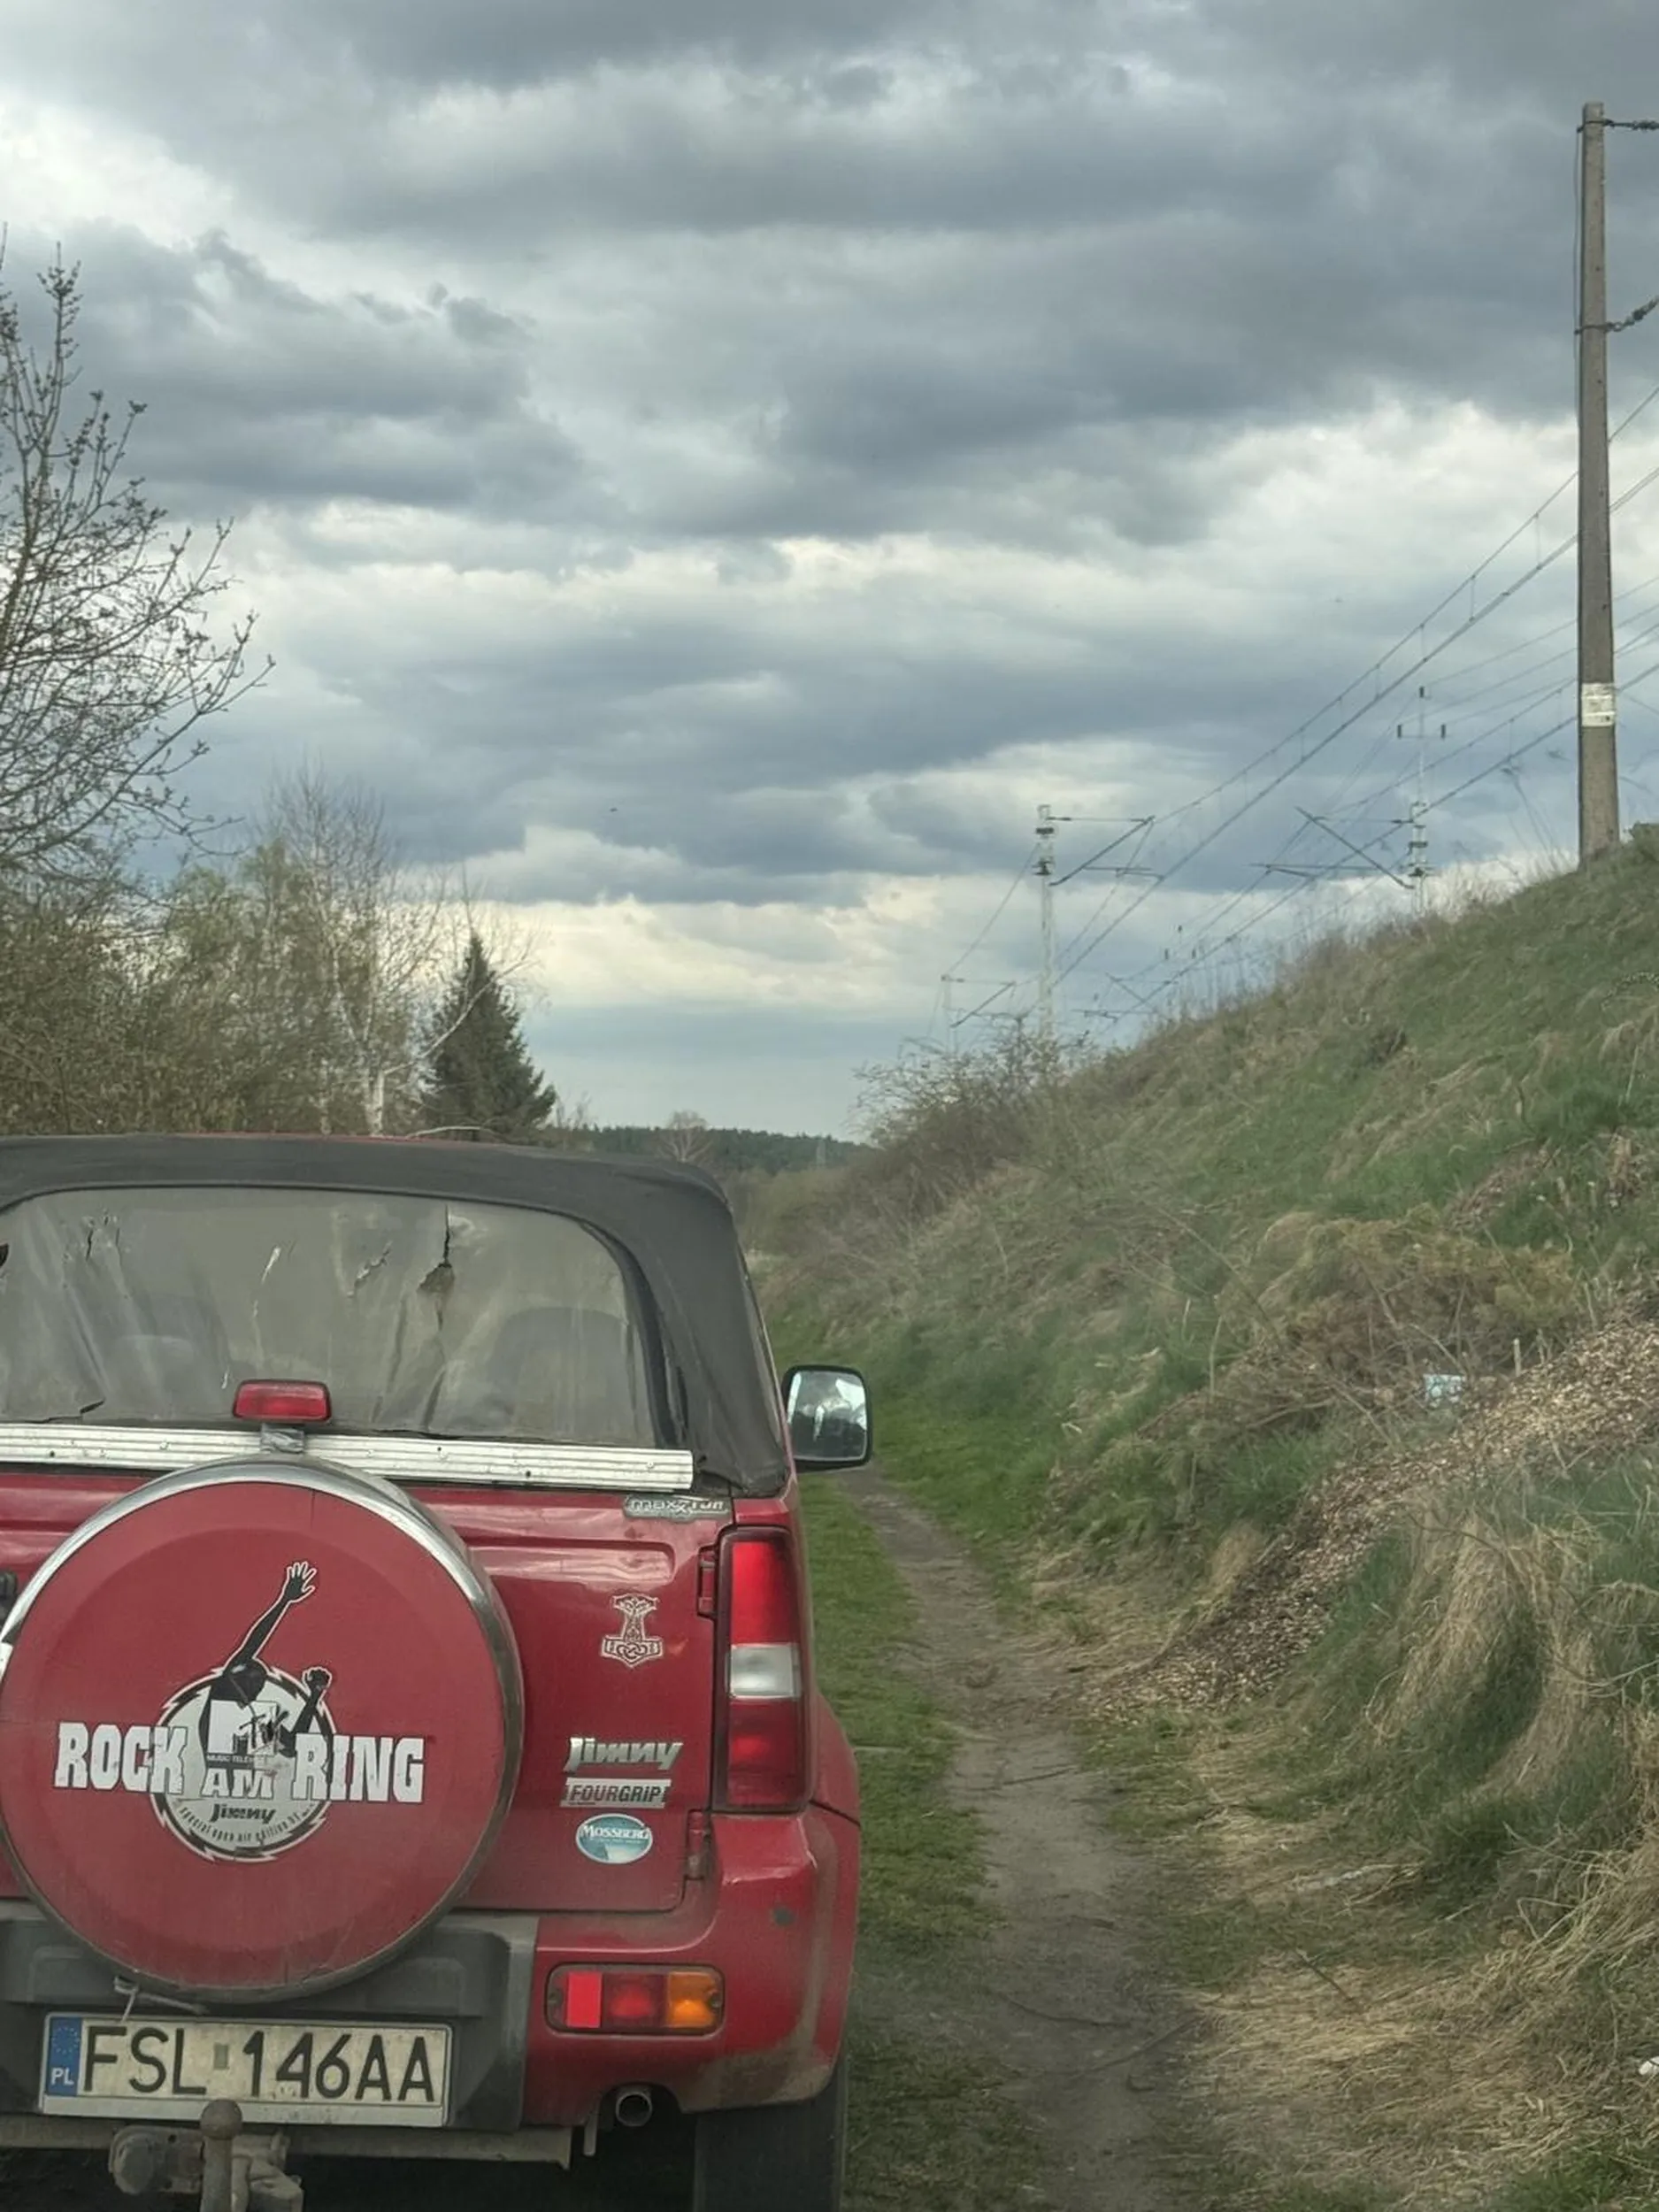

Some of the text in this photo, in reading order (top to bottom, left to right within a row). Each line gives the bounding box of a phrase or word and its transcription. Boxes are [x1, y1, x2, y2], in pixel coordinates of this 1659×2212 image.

[54, 1722, 425, 1802] ROCK AM RING
[563, 1737, 684, 1771] Jimny
[210, 1804, 276, 1824] Jimny
[50, 2067, 74, 2085] PL
[84, 2026, 434, 2101] FSL 146AA
